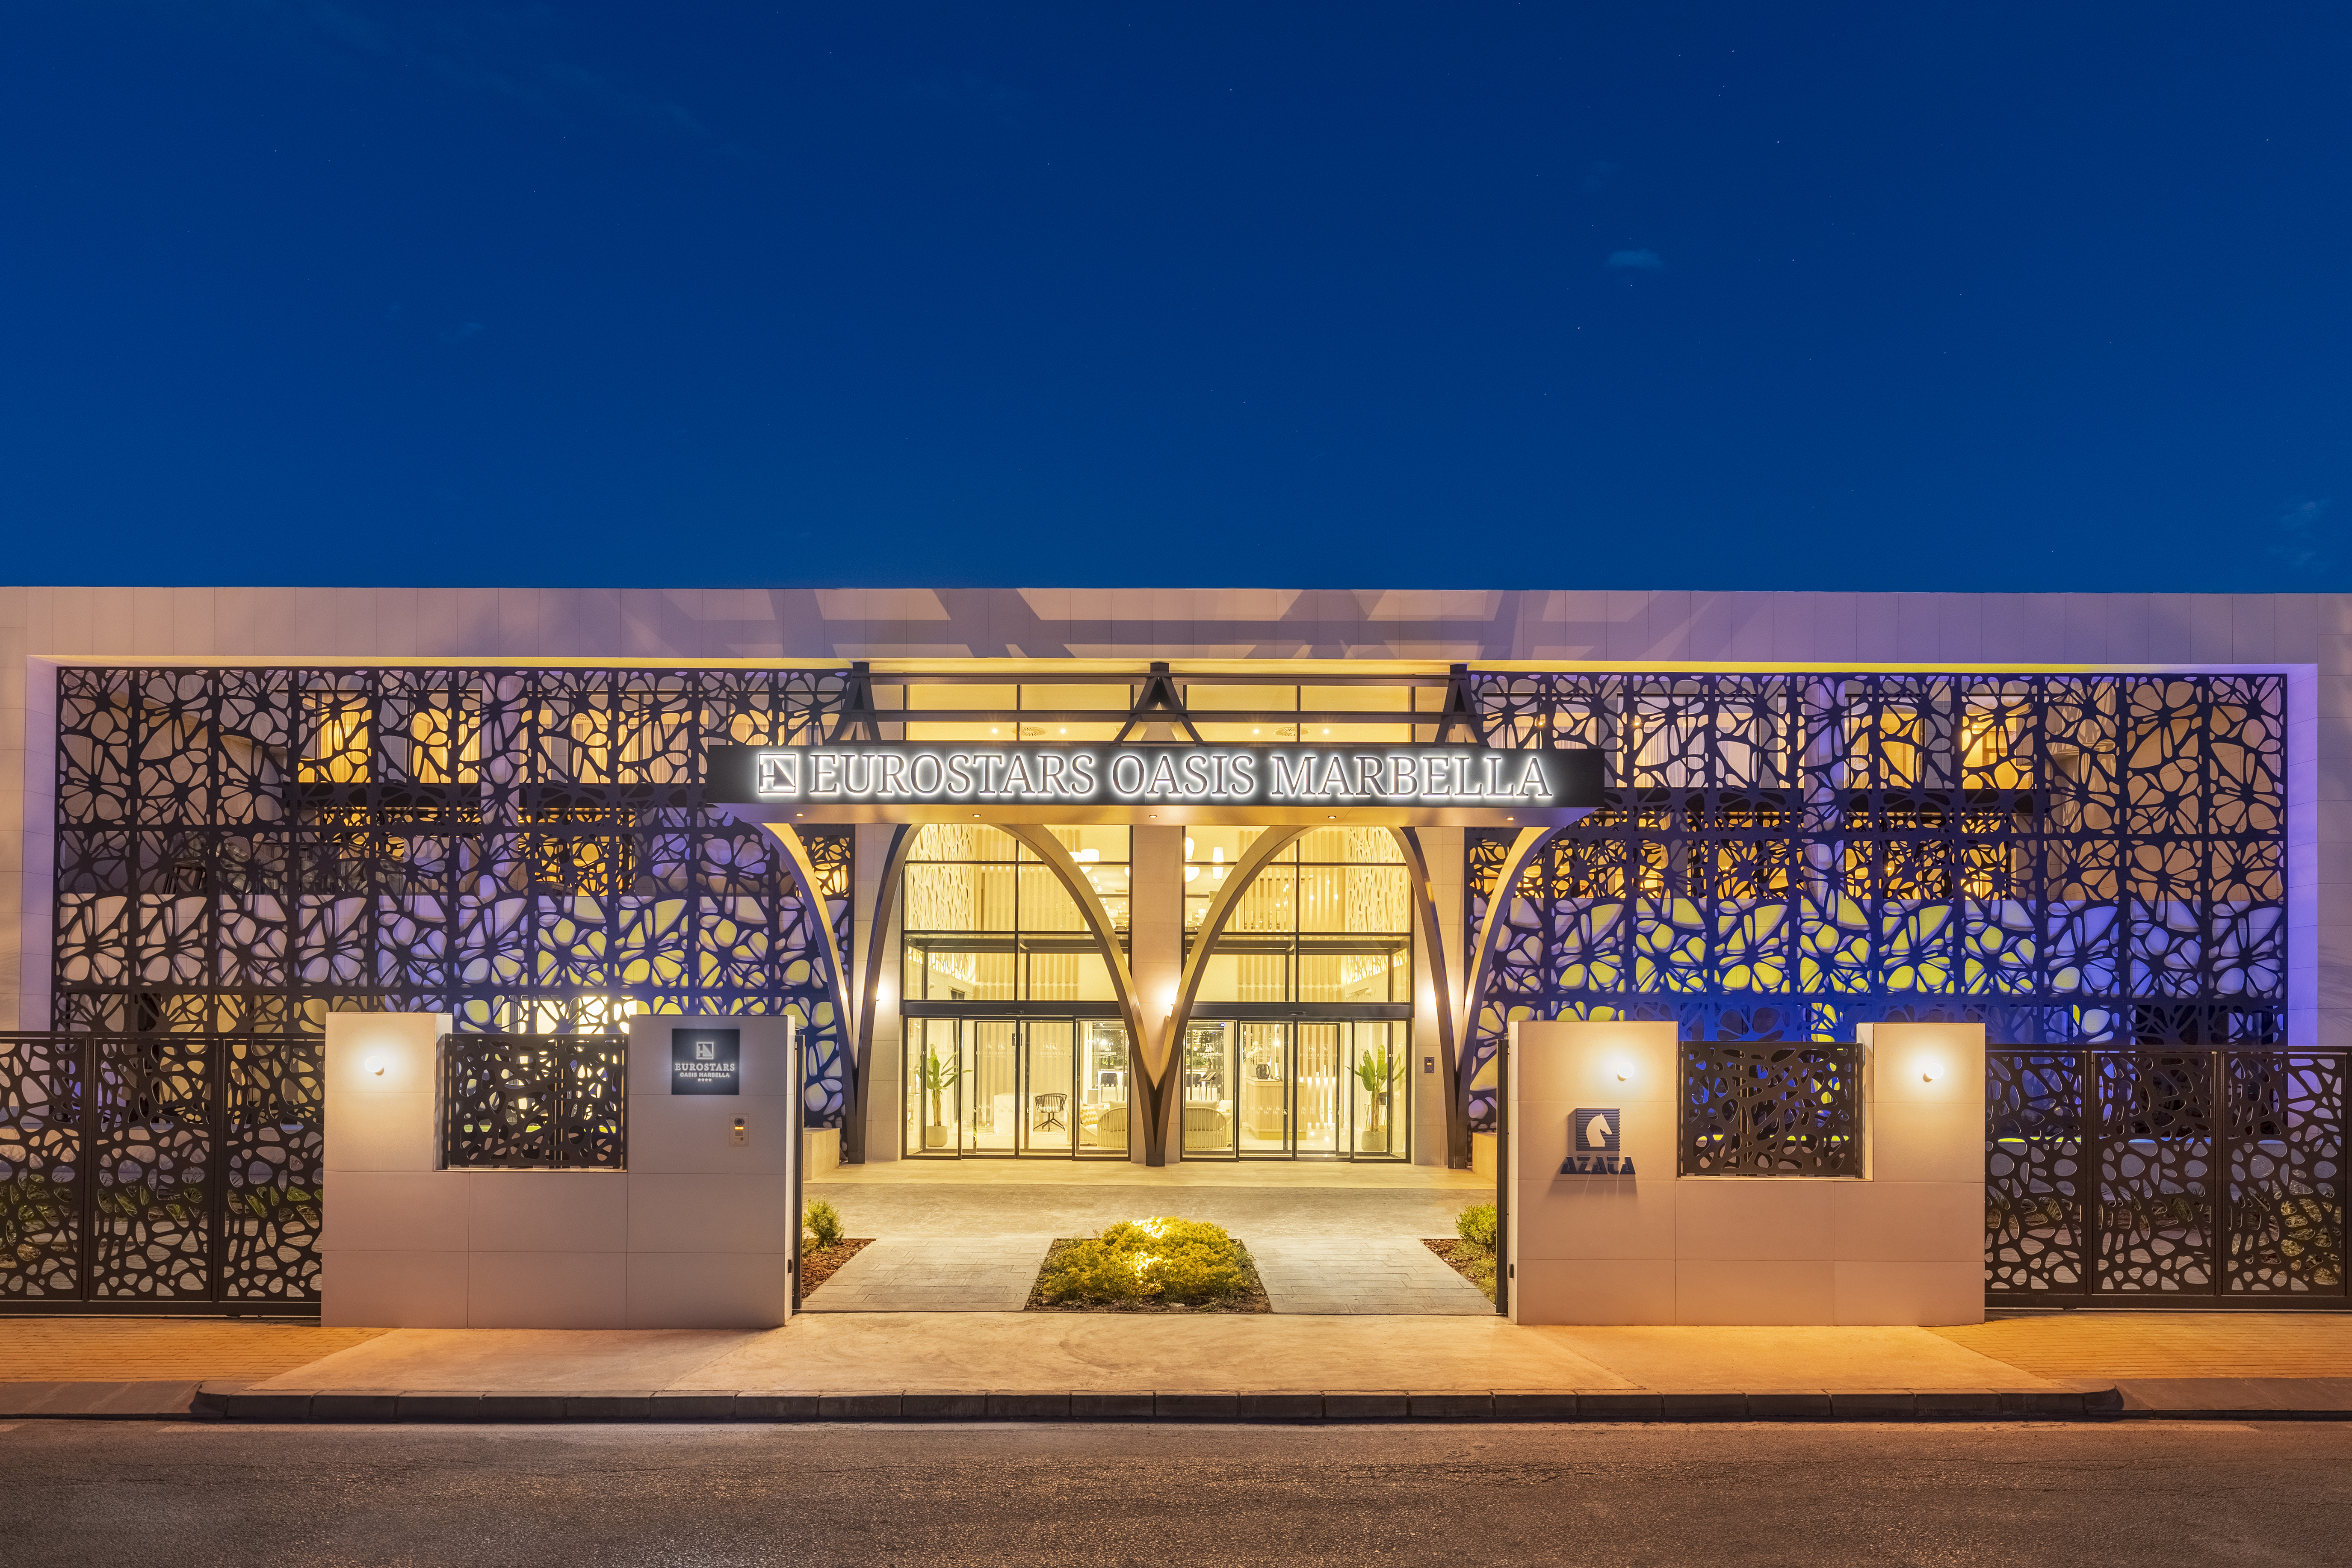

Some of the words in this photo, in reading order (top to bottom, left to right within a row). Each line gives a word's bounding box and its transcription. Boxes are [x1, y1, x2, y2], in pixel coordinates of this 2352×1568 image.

[809, 754, 1094, 796] EUROSTARS
[1112, 755, 1254, 797] OASIS
[1271, 756, 1553, 798] MARBELLA
[674, 1063, 735, 1071] EUROSTARS
